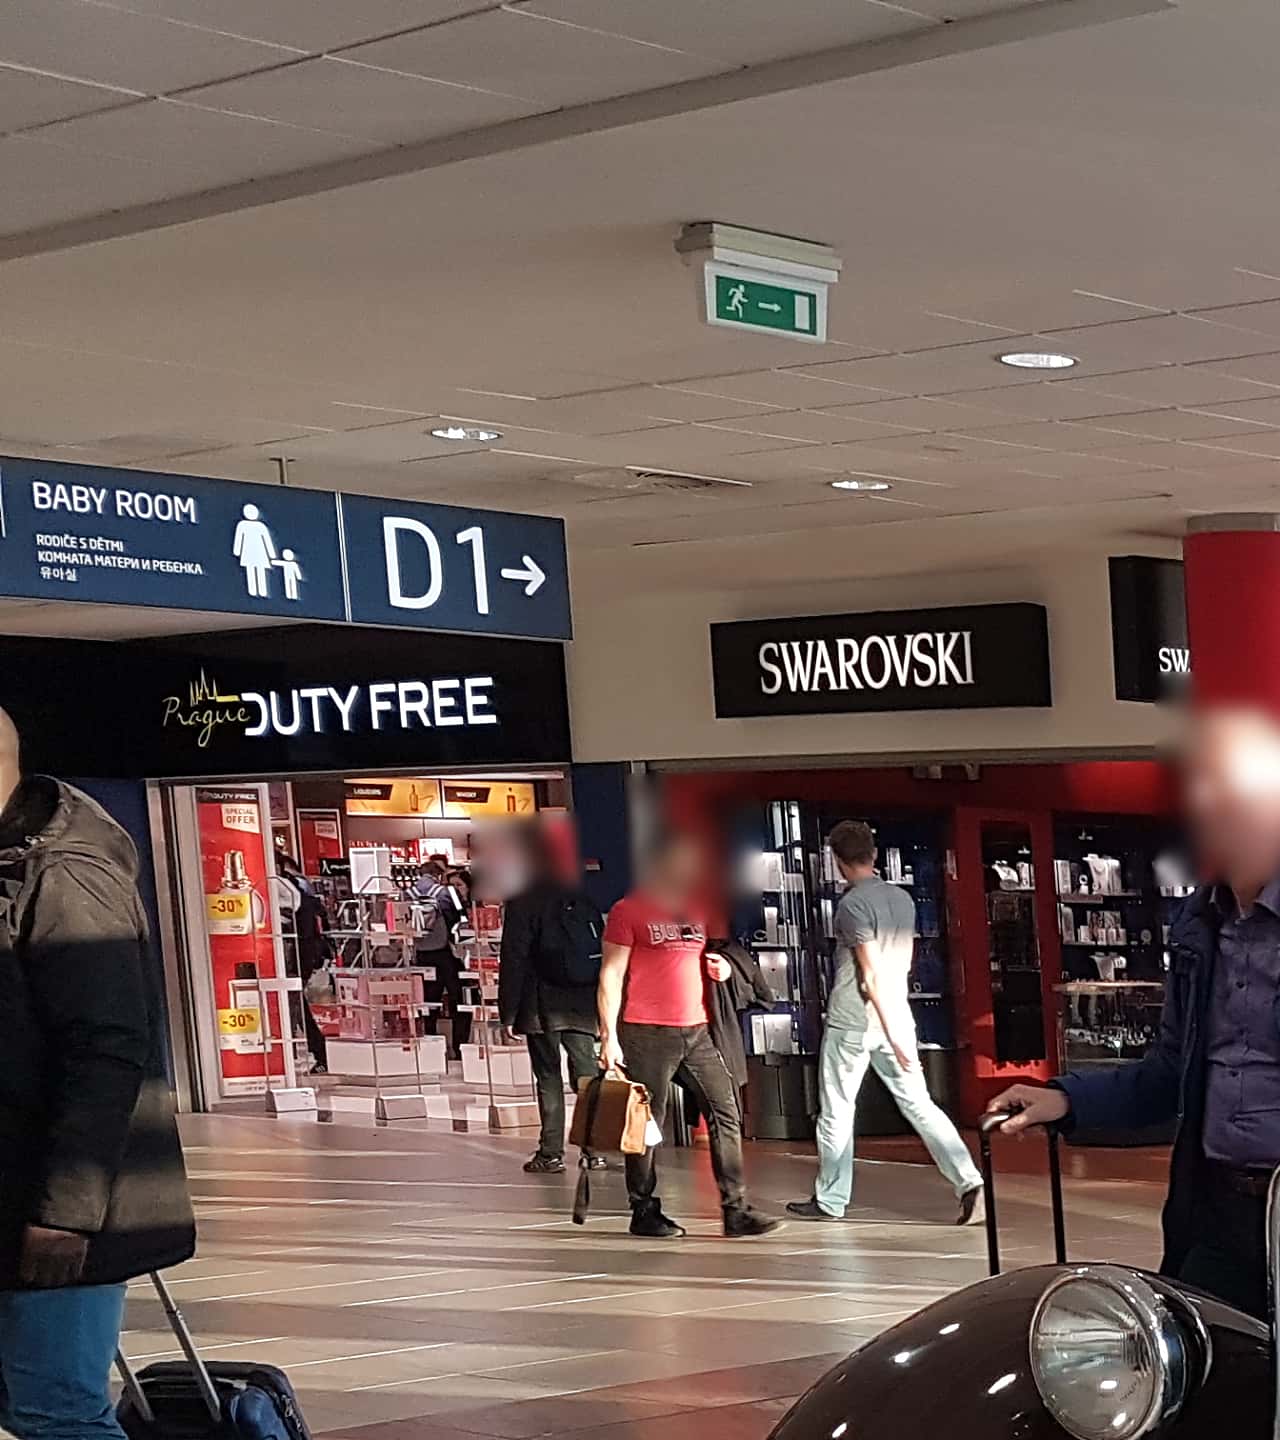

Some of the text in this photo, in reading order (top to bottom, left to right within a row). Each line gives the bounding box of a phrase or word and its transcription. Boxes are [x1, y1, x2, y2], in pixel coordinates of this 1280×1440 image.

[32, 481, 198, 524] BABY ROOM
[36, 533, 124, 552] RODIČE S DĚTMI
[38, 551, 204, 575] КОМНАТА МАТЕРИ И РЕБЕНКА
[383, 516, 489, 614] D1
[759, 631, 975, 694] SWAROVSKI
[1158, 647, 1191, 673] SW
[162, 696, 250, 747] Prague
[240, 677, 497, 736] DUTY FREE
[226, 816, 256, 824] OFFER
